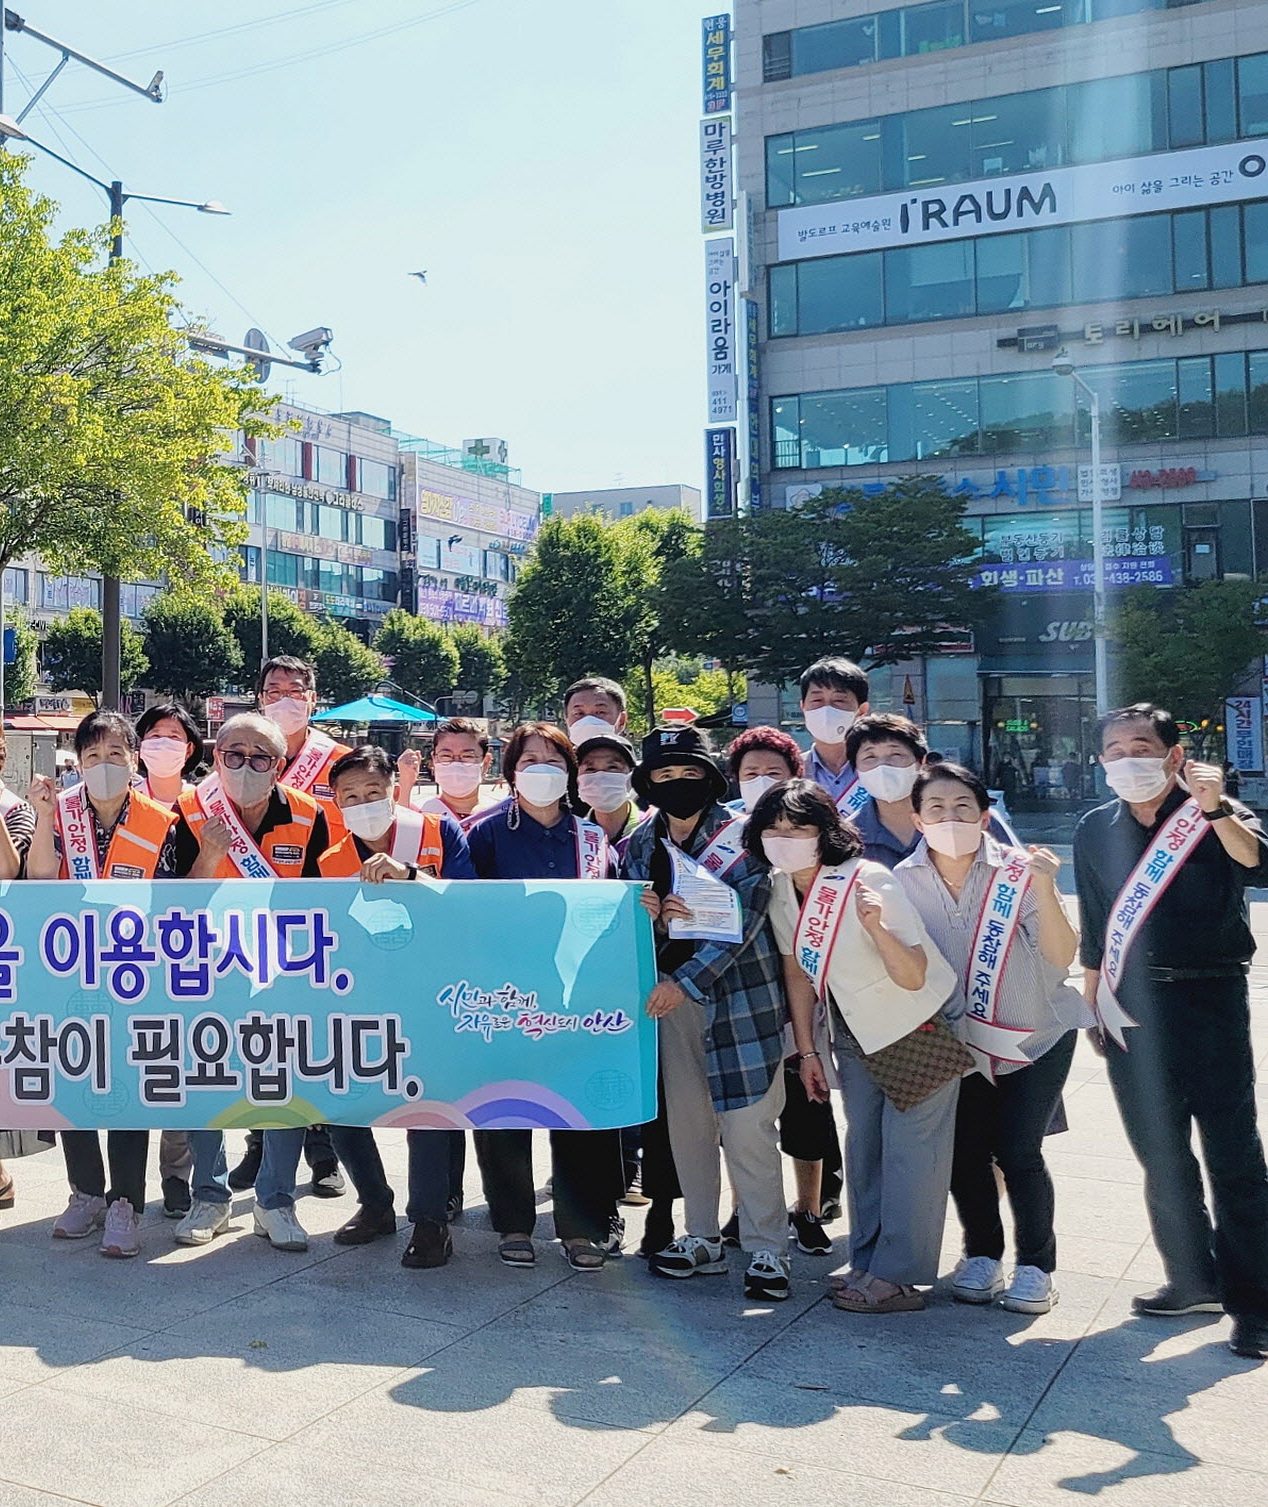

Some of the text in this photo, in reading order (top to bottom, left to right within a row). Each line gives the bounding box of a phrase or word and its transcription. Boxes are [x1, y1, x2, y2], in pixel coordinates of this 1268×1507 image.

[706, 30, 725, 91] 세무회계
[704, 122, 727, 225] 마루한방병원
[1113, 170, 1234, 195] 아이 삶을 그리는 공간
[798, 226, 836, 242] 발도르프
[841, 218, 892, 236] 교육예술원
[710, 280, 731, 361] 아이라움
[1084, 309, 1220, 347] 토리헤어
[712, 397, 727, 405] 411
[712, 405, 732, 414] 4971
[64, 795, 88, 855] 물가안정
[1165, 804, 1203, 852] 가안정
[1143, 849, 1174, 884] 함께
[991, 883, 1019, 919] 함께
[1116, 881, 1152, 930] 동참해
[43, 909, 349, 998] 이용합시다.
[800, 885, 838, 976] 물가안정 함께
[977, 918, 1005, 971] 동참해
[439, 982, 494, 1016] 시민과
[971, 969, 992, 1019] 주세요
[456, 1010, 633, 1040] 자유로운 혁신도시 안산
[131, 1017, 419, 1102] 필요합니다.
